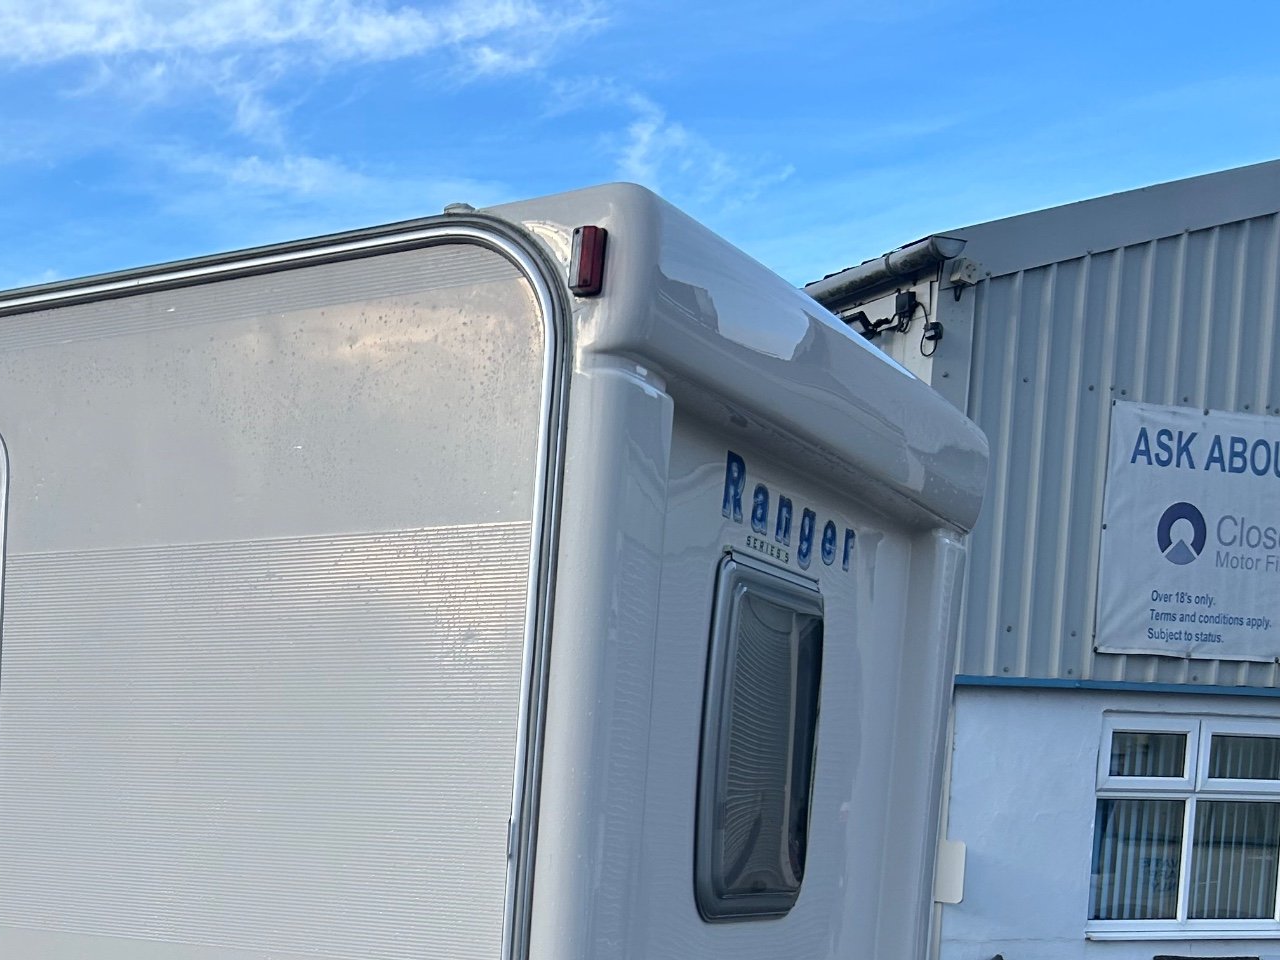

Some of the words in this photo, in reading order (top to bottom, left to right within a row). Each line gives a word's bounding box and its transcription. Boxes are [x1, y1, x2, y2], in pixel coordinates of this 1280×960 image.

[1130, 426, 1198, 470] ASK
[722, 450, 856, 572] Ranger
[1217, 515, 1280, 550] Clos
[746, 535, 780, 560] SERIES
[1215, 550, 1261, 570] Motor
[1151, 590, 1173, 602] Over
[1175, 592, 1192, 603] 18's
[1194, 593, 1216, 608] only.
[1150, 608, 1176, 622] Terms
[1179, 612, 1196, 623] and
[1198, 613, 1244, 626] conditions
[1246, 616, 1272, 630] apply.
[1147, 628, 1182, 642] Subject
[1184, 631, 1193, 641] to
[1194, 632, 1224, 643] status.
